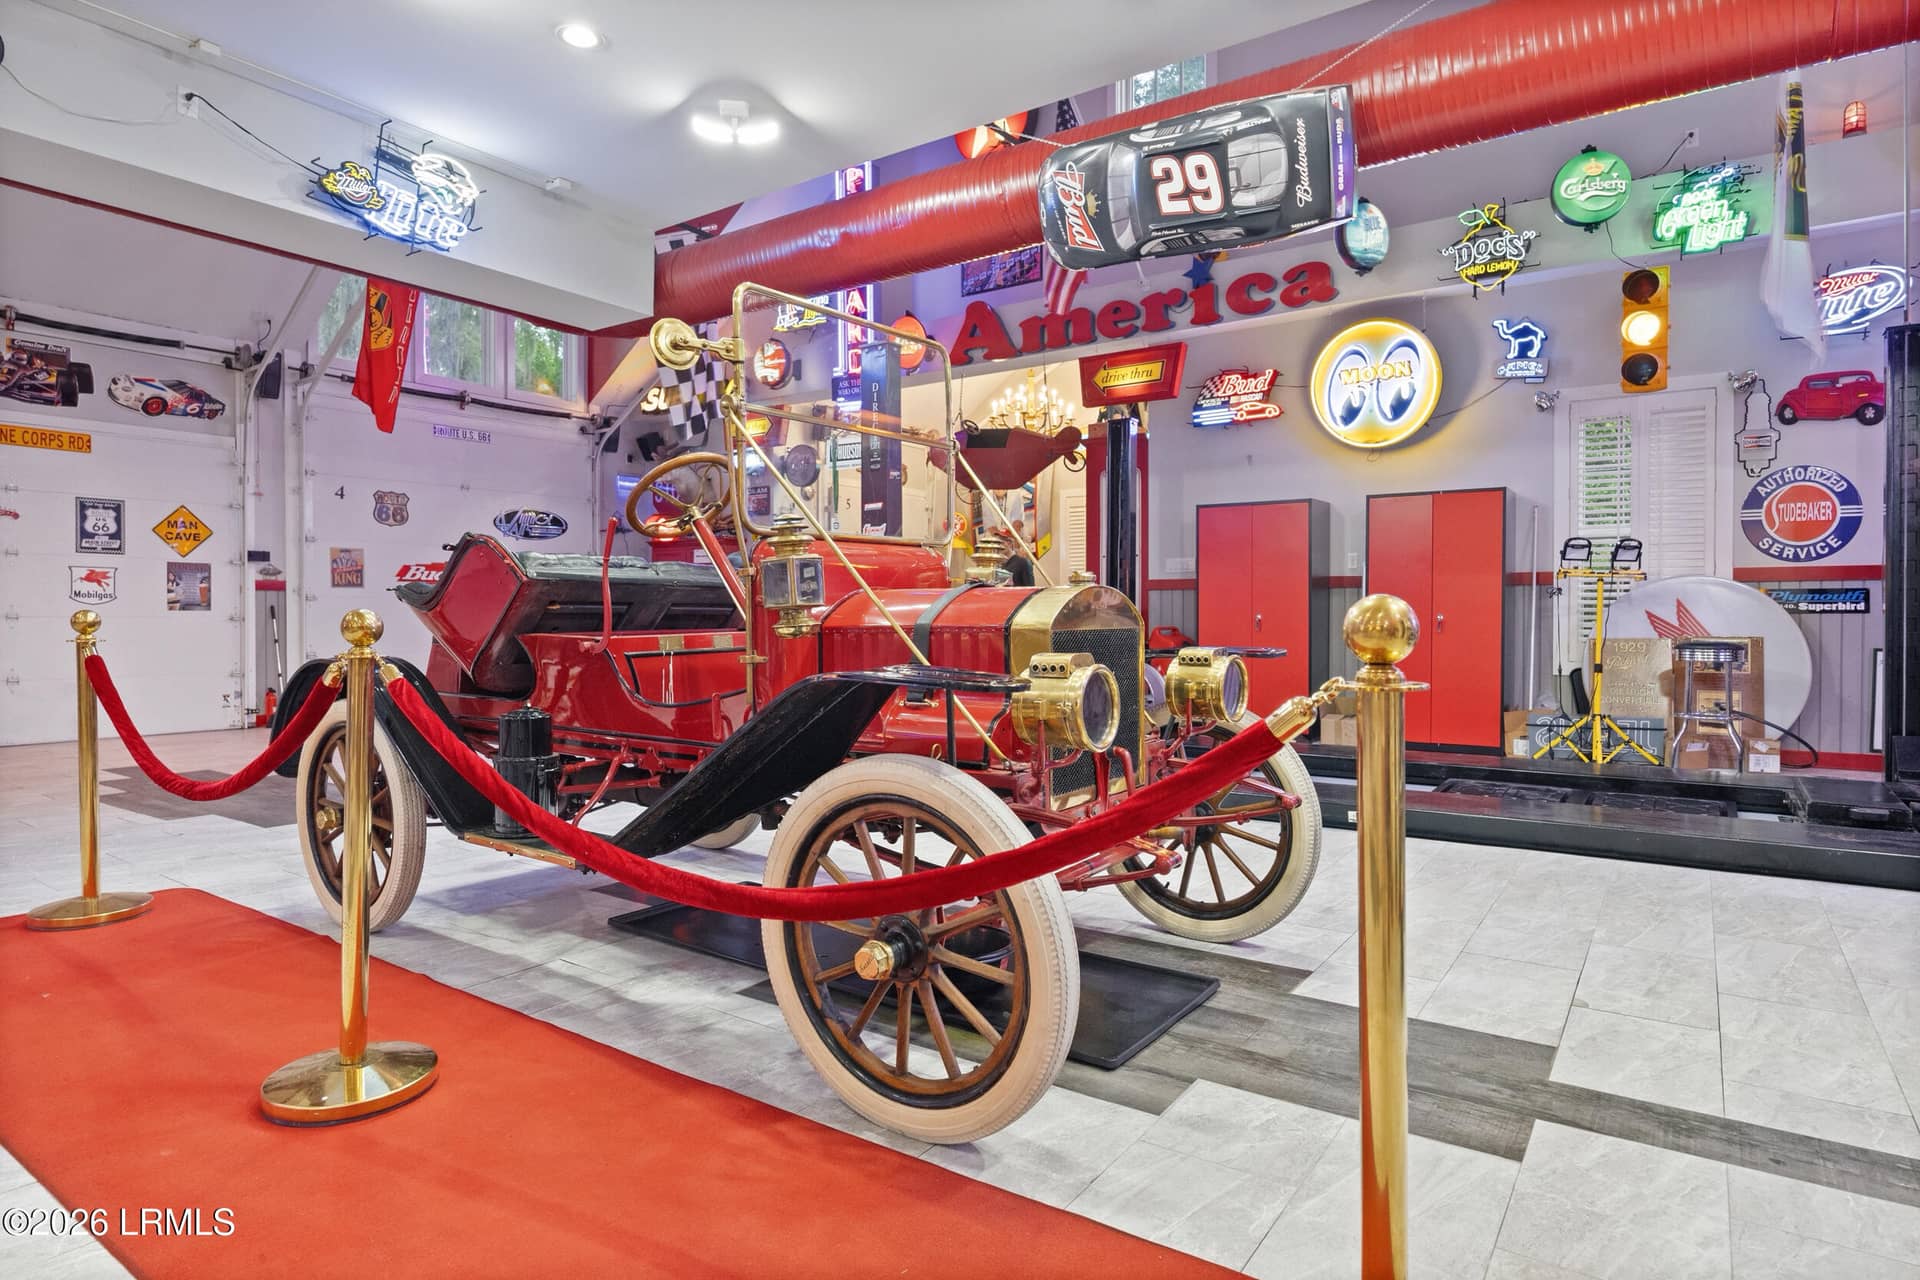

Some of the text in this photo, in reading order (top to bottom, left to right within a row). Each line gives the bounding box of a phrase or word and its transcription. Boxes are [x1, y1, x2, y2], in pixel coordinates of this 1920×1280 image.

[1293, 117, 1313, 208] Budweiser
[336, 171, 376, 197] Miller
[1151, 152, 1223, 215] 29
[1560, 173, 1626, 200] Carlsberg
[1053, 161, 1100, 249] Bud
[1656, 199, 1730, 242] Green
[1684, 211, 1749, 252] Light
[1460, 260, 1519, 277] HARD LEMON
[1819, 272, 1879, 297] Miller
[951, 259, 1338, 366] America
[1101, 367, 1153, 384] drive thru
[1339, 360, 1414, 386] MOON
[1218, 369, 1274, 397] Bud
[187, 403, 201, 414] 6
[22, 430, 64, 448] CORPS
[437, 426, 460, 438] ROUTE
[478, 432, 487, 442] 66
[1756, 467, 1848, 497] AUTHORIZED
[334, 485, 345, 499] 4
[845, 498, 851, 510] 5
[167, 519, 198, 530] MAN
[1771, 500, 1833, 532] STUDEBAKER
[92, 522, 110, 533] 66
[165, 532, 201, 542] CAVE
[1759, 535, 1842, 559] SERVICE
[334, 572, 361, 585] KING
[74, 590, 114, 601] Mobilgas
[1768, 589, 1867, 603] Plymouth
[1798, 602, 1866, 612] Superbird
[1613, 641, 1647, 654] 1929
